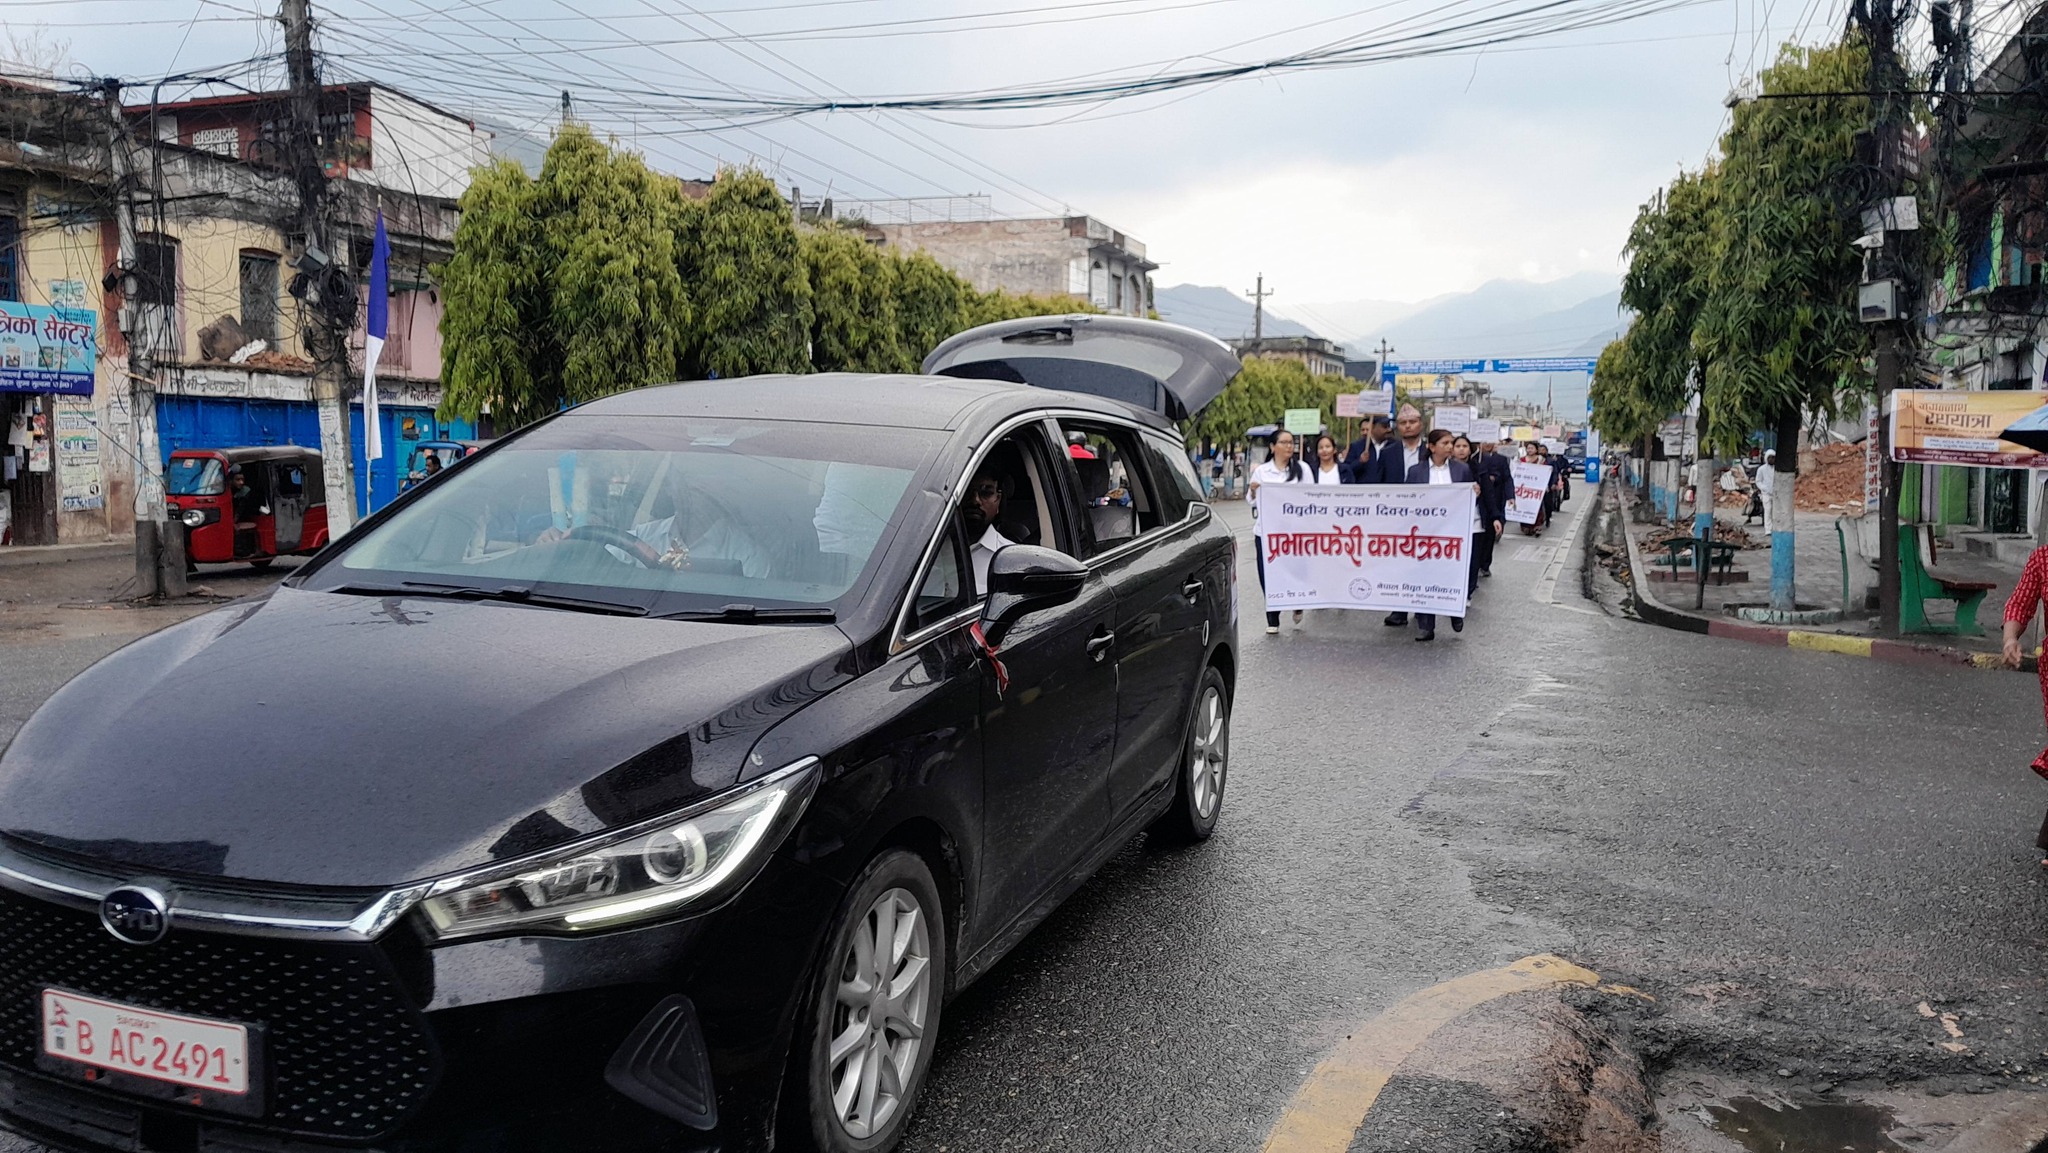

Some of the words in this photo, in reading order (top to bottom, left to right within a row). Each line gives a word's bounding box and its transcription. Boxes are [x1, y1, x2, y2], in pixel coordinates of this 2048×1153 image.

[0, 309, 37, 336] त्रिका
[43, 314, 92, 350] सेन्टर
[1925, 412, 1993, 429] रथयात्रा
[1514, 484, 1544, 500] र्यक्रम
[1282, 502, 1328, 516] विद्युतीय
[1334, 503, 1370, 518] सुरक्षा
[1267, 525, 1364, 567] प्रभातफेरी
[1367, 526, 1464, 561] कार्यक्रम
[76, 1020, 94, 1056] B
